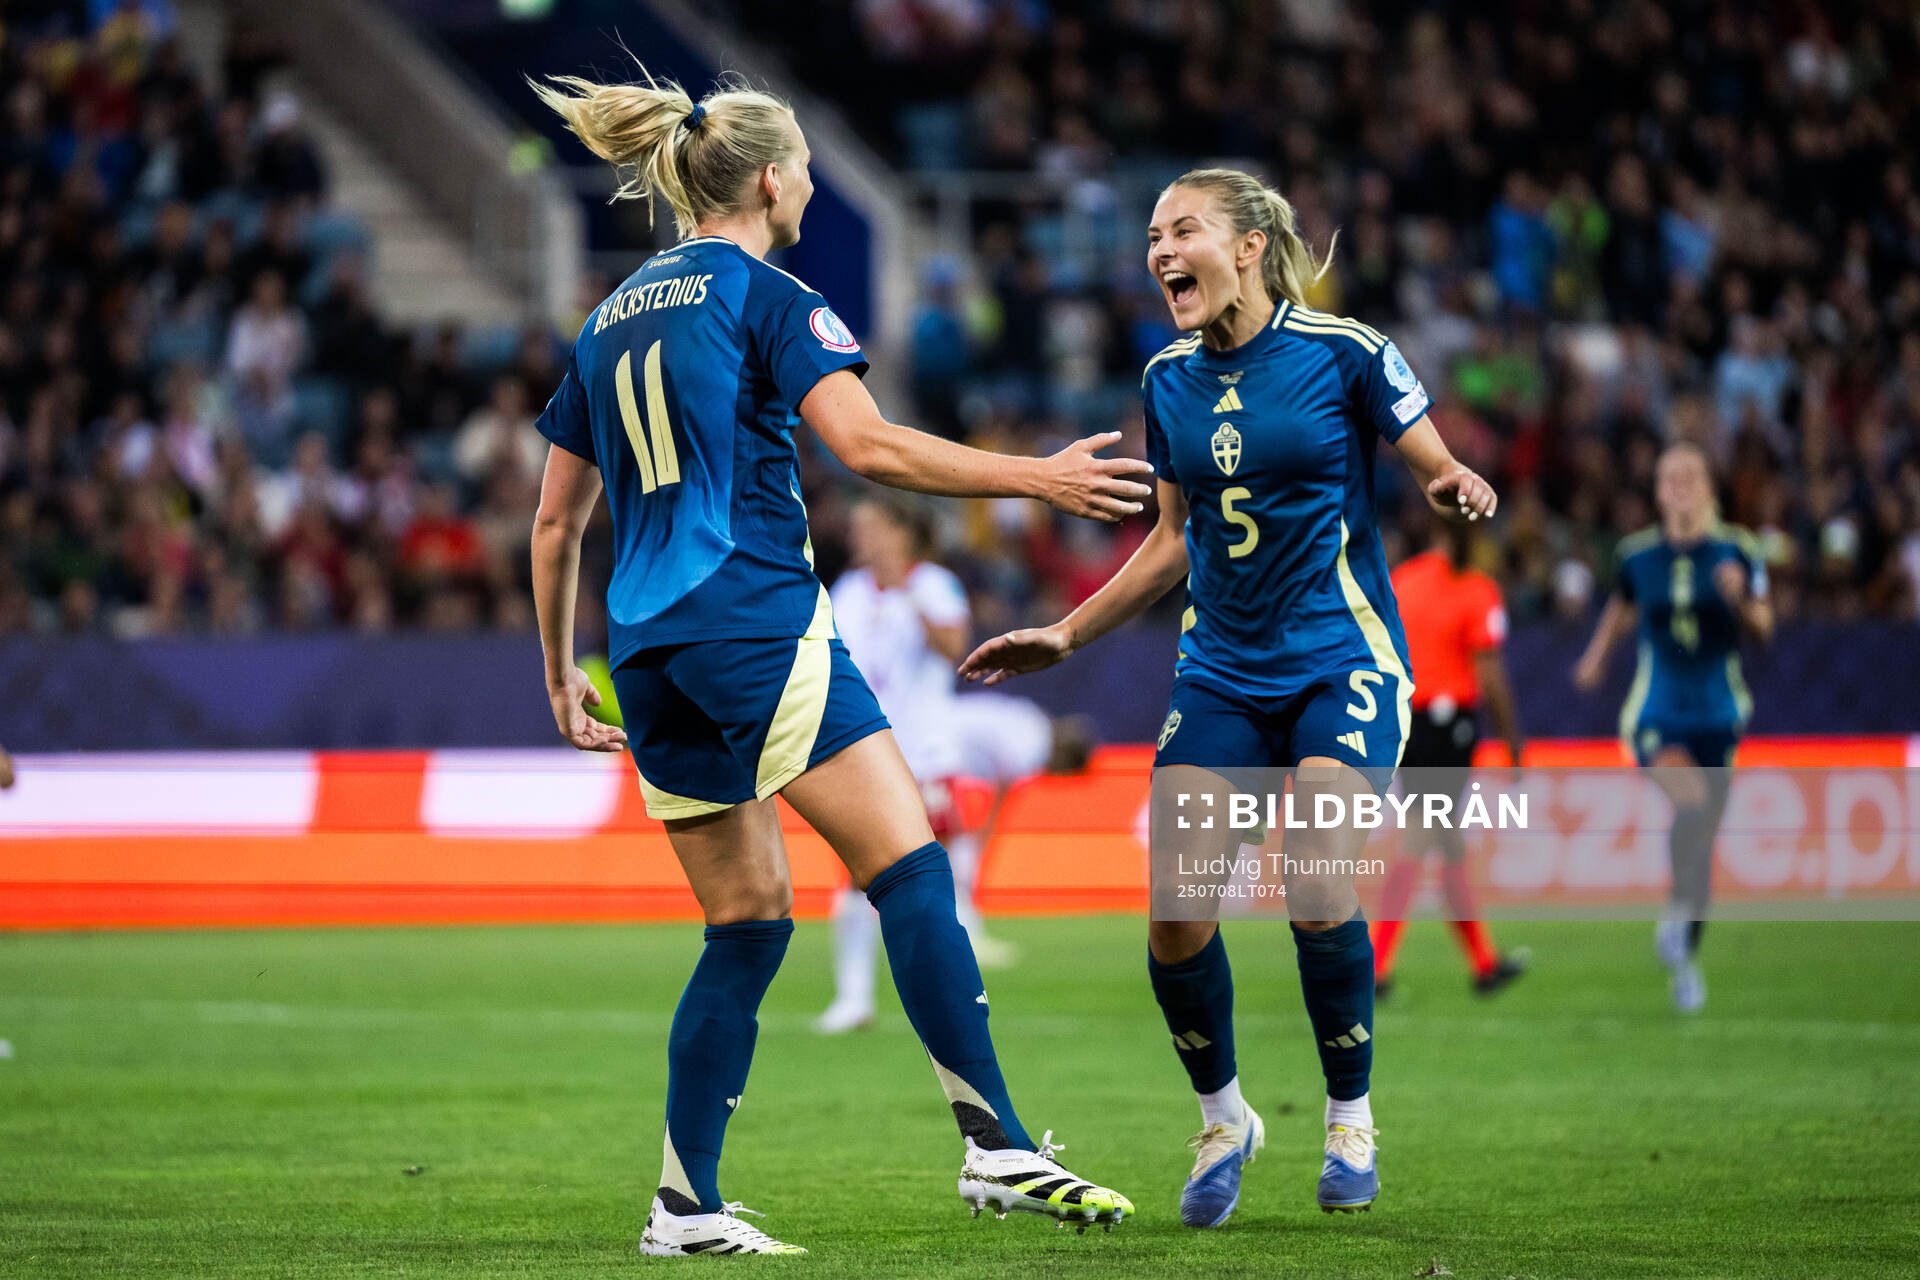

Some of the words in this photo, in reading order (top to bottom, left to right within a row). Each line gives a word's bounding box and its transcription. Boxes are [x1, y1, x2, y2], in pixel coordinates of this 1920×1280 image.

[593, 273, 714, 336] BLACKSTENIUS
[615, 339, 681, 495] 11
[1220, 486, 1259, 559] 5
[1346, 669, 1384, 722] 5
